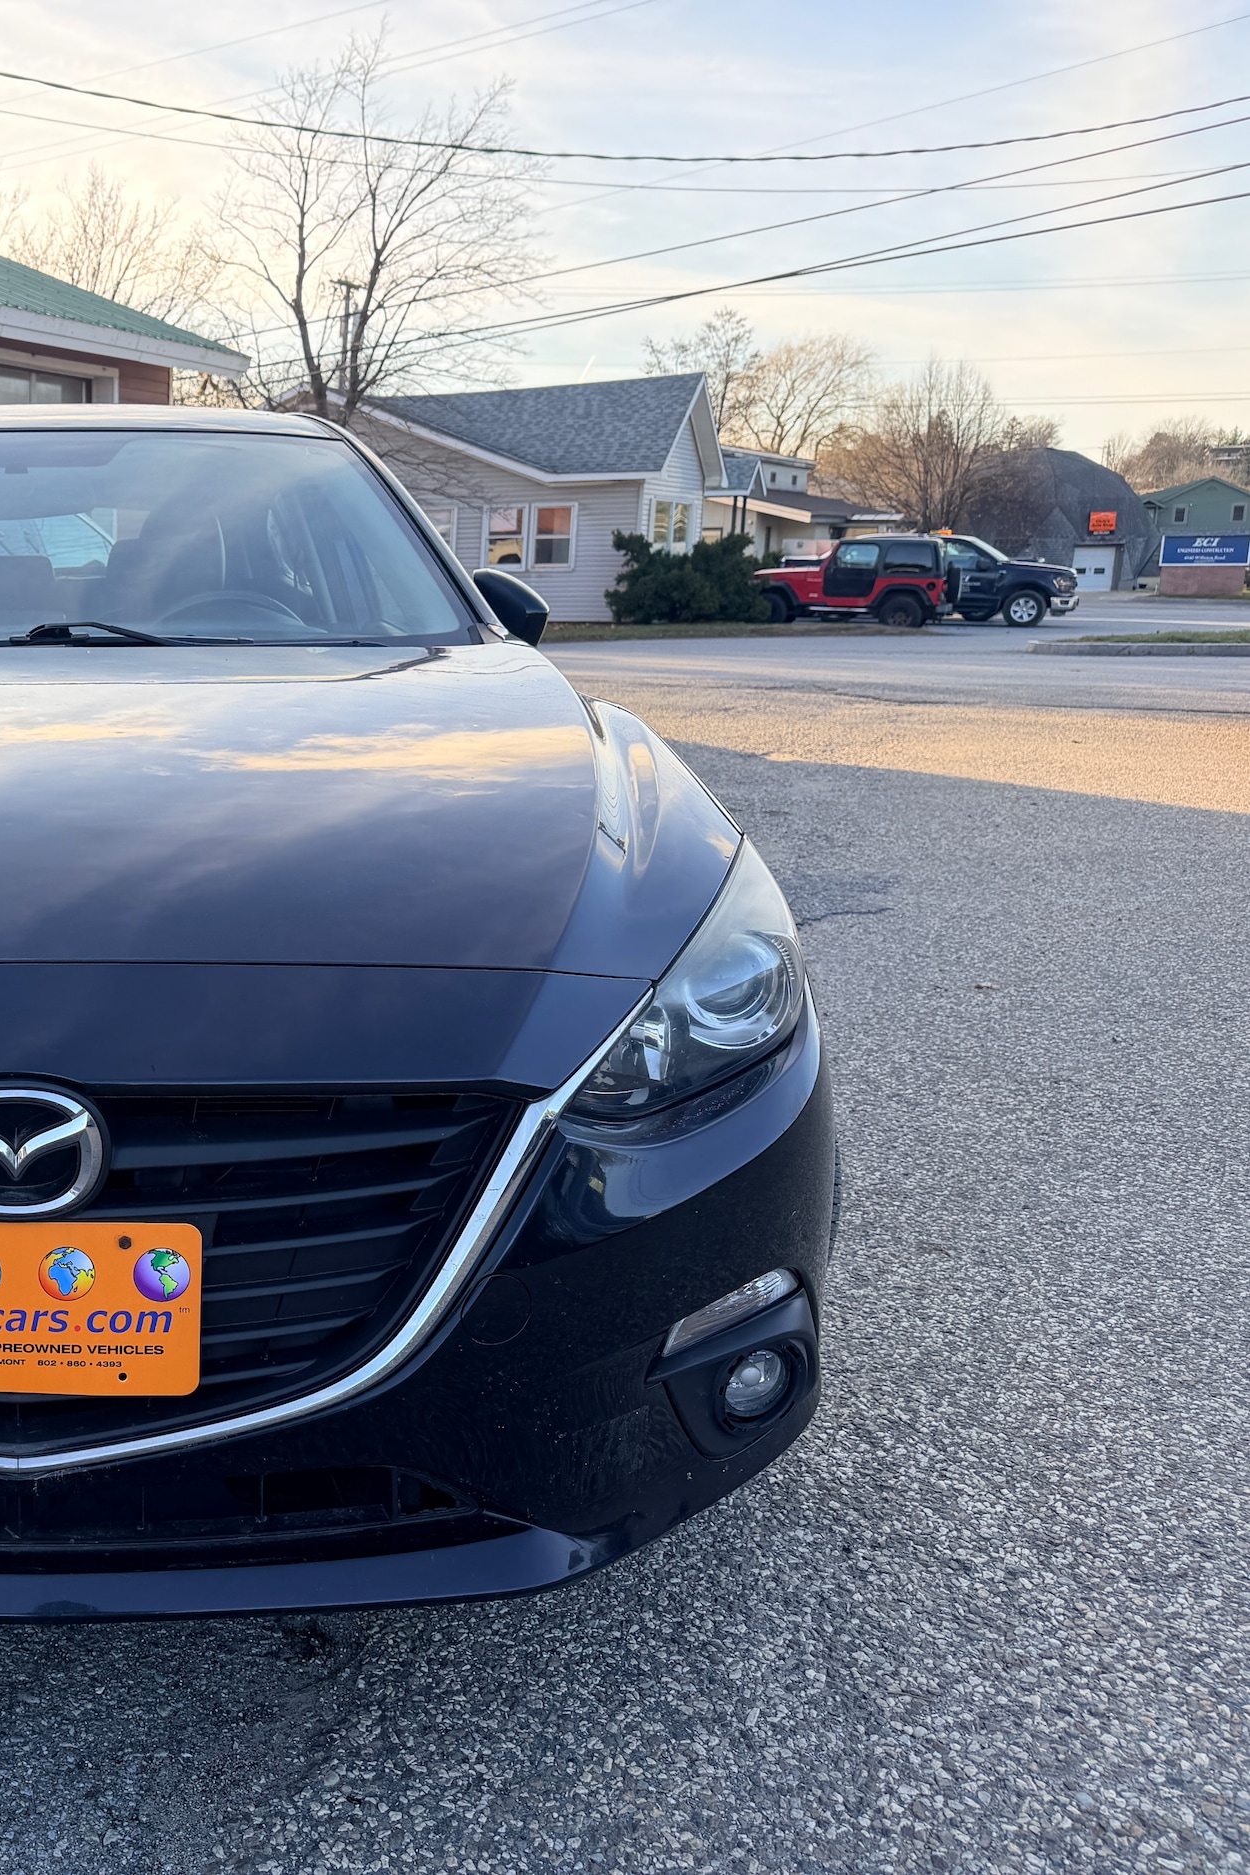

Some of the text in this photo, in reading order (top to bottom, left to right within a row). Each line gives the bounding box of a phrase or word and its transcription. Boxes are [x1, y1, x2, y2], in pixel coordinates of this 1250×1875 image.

[1192, 537, 1221, 547] ECI
[87, 1344, 165, 1355] VEHICLES
[37, 1359, 57, 1367] 802
[95, 1360, 123, 1368] 4393
